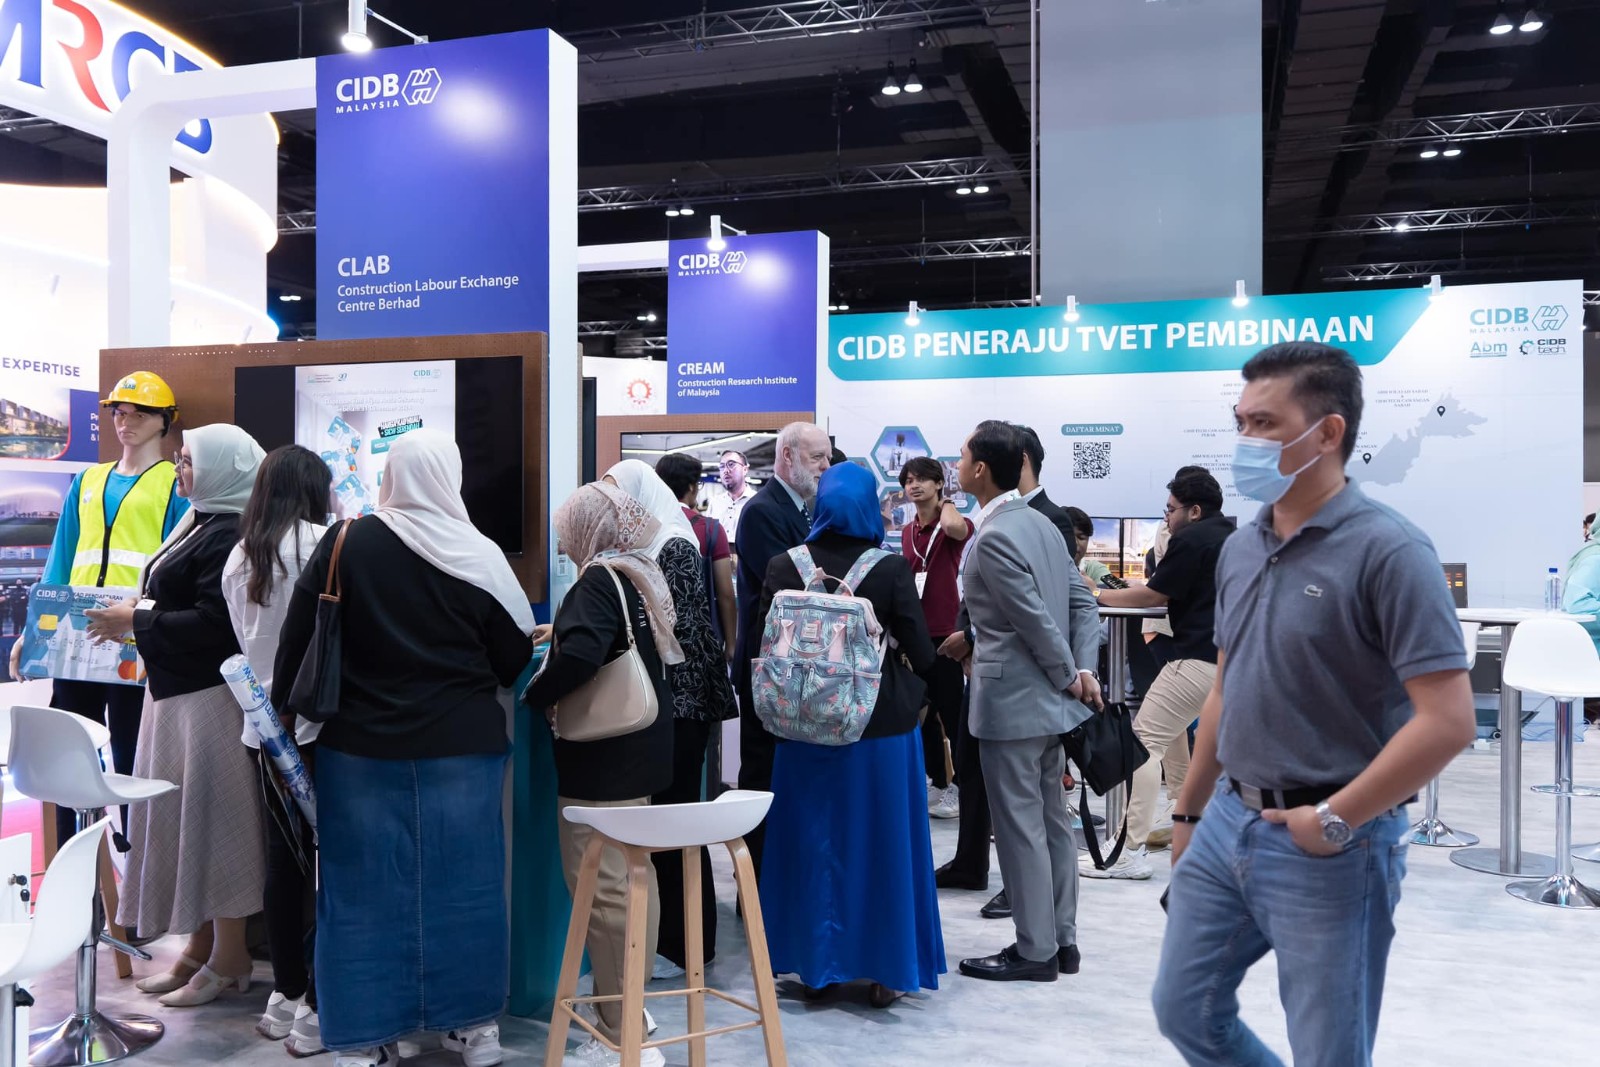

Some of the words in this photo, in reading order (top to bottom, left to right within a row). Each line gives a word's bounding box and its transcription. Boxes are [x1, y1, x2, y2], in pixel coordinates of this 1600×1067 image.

[336, 73, 399, 102] CIDB
[336, 100, 399, 114] MALAYSIA
[338, 255, 390, 276] CLAB
[678, 253, 720, 270] CIDB
[337, 282, 412, 296] Construction
[415, 278, 457, 292] Labour
[460, 275, 520, 289] Exchange
[337, 300, 376, 312] Centre
[378, 295, 420, 310] Berhad
[1470, 307, 1530, 326] CIDB
[837, 334, 906, 360] CIDB
[914, 327, 1070, 358] PENERAJU
[1076, 324, 1158, 350] TVET
[1166, 314, 1374, 348] PEMBINAAN
[1470, 341, 1508, 352] Abm
[2, 357, 80, 378] EXPERTISE
[678, 362, 725, 376] CREAM
[678, 378, 726, 388] Construction
[728, 377, 762, 386] Research
[764, 376, 798, 385] Institute
[678, 388, 686, 397] of
[686, 388, 720, 398] Malaysia
[36, 589, 57, 598] CIDB
